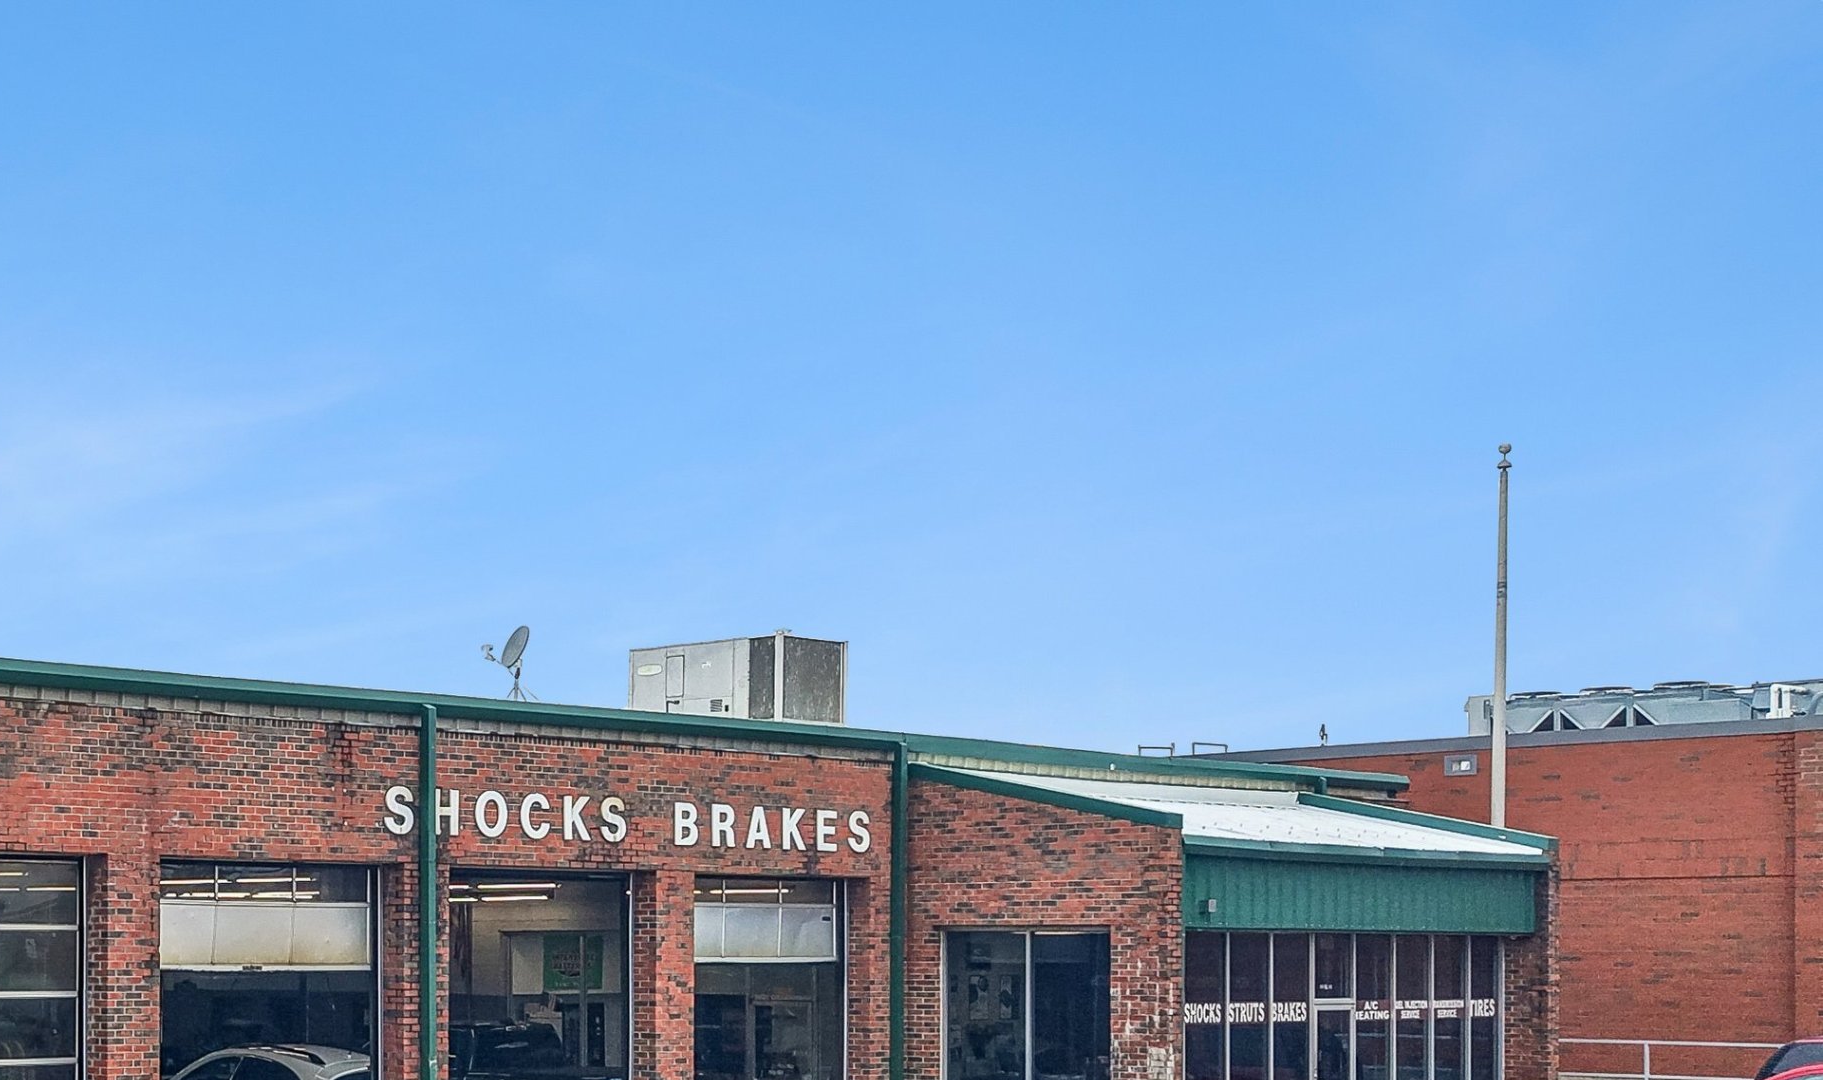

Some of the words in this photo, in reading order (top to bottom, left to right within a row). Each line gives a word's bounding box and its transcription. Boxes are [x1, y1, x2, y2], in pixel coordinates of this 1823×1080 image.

[383, 785, 627, 842] SHOCKS
[674, 801, 871, 853] BRAKES
[1183, 1003, 1222, 1024] SHOCKS
[1228, 1002, 1265, 1023] STRUTS
[1272, 1002, 1307, 1022] BRAKES
[1363, 1001, 1379, 1010] A/C
[1469, 999, 1496, 1017] TIRES
